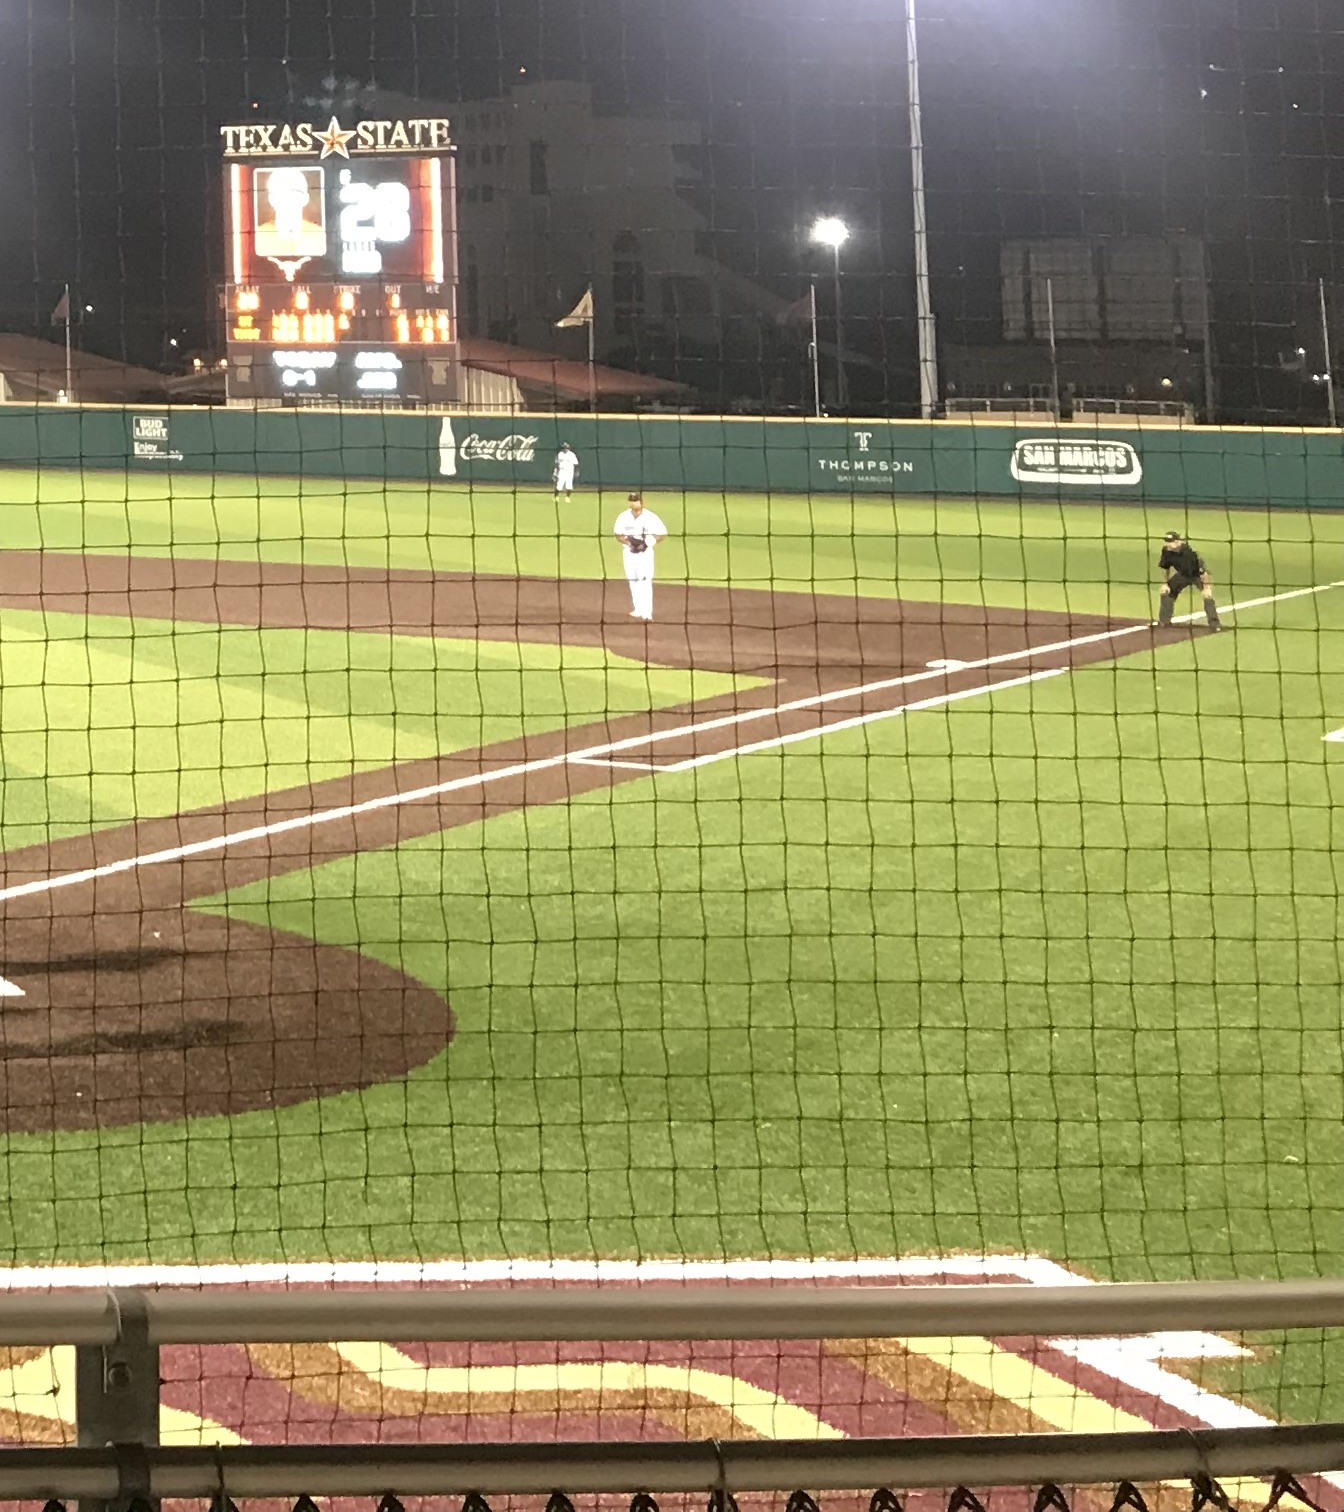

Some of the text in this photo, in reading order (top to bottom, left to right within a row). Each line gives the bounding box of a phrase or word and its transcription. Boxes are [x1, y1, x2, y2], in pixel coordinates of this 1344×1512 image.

[221, 119, 450, 153] TEXAS STATE
[140, 419, 164, 429] BUD
[135, 427, 168, 437] LIGHT
[1023, 444, 1127, 468] SAN MARCOS
[818, 459, 914, 472] THOMPSON
